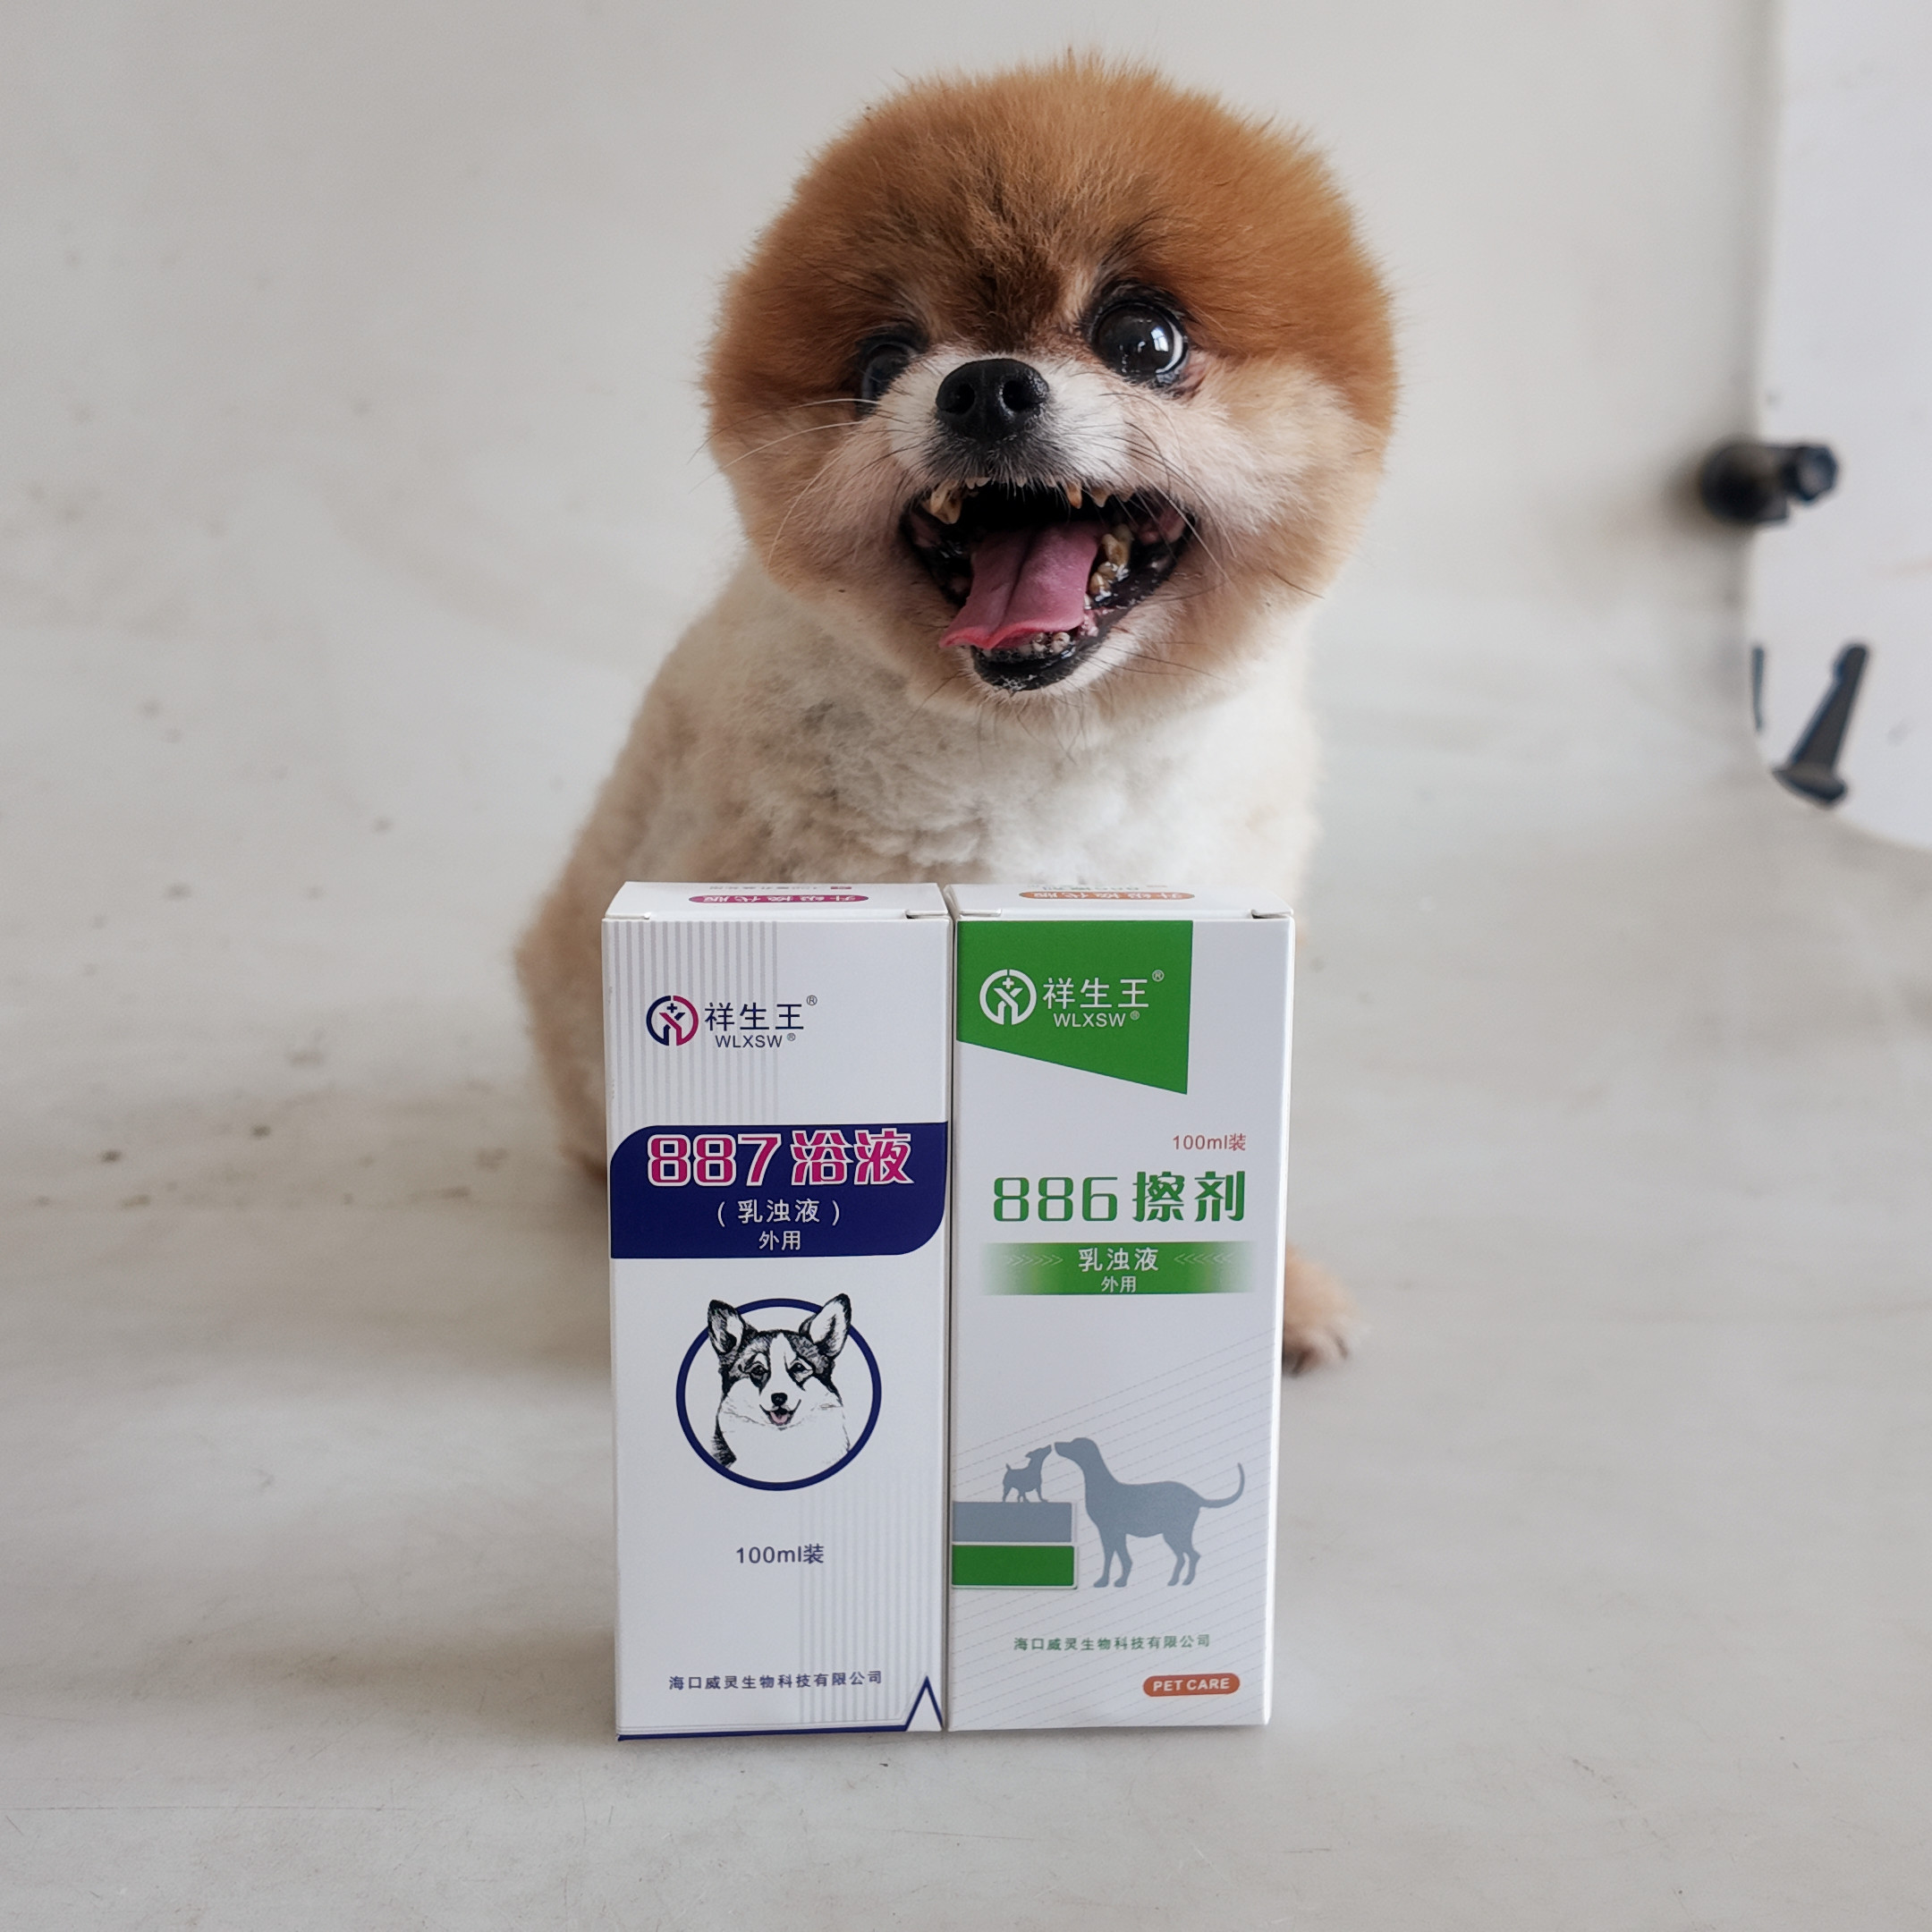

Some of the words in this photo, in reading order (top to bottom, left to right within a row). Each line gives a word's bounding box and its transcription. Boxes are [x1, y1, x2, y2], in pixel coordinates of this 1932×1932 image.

[1042, 977, 1149, 1010] 祥生王
[703, 1001, 804, 1031] 祥生王
[1053, 1013, 1127, 1028] WLXSW
[715, 1034, 784, 1048] WLXSW
[1172, 1132, 1247, 1152] 100ml装
[758, 1230, 801, 1251] 外用
[1078, 1247, 1159, 1273] 乳浊液
[1100, 1275, 1137, 1293] 外用
[735, 1543, 825, 1564] 100ml装
[1013, 1633, 1210, 1651] 海口威灵生物科技有限公司
[668, 1670, 882, 1691] 海口威灵生物科技有限公司
[1152, 1679, 1182, 1692] PET
[1186, 1677, 1231, 1691] CARE
